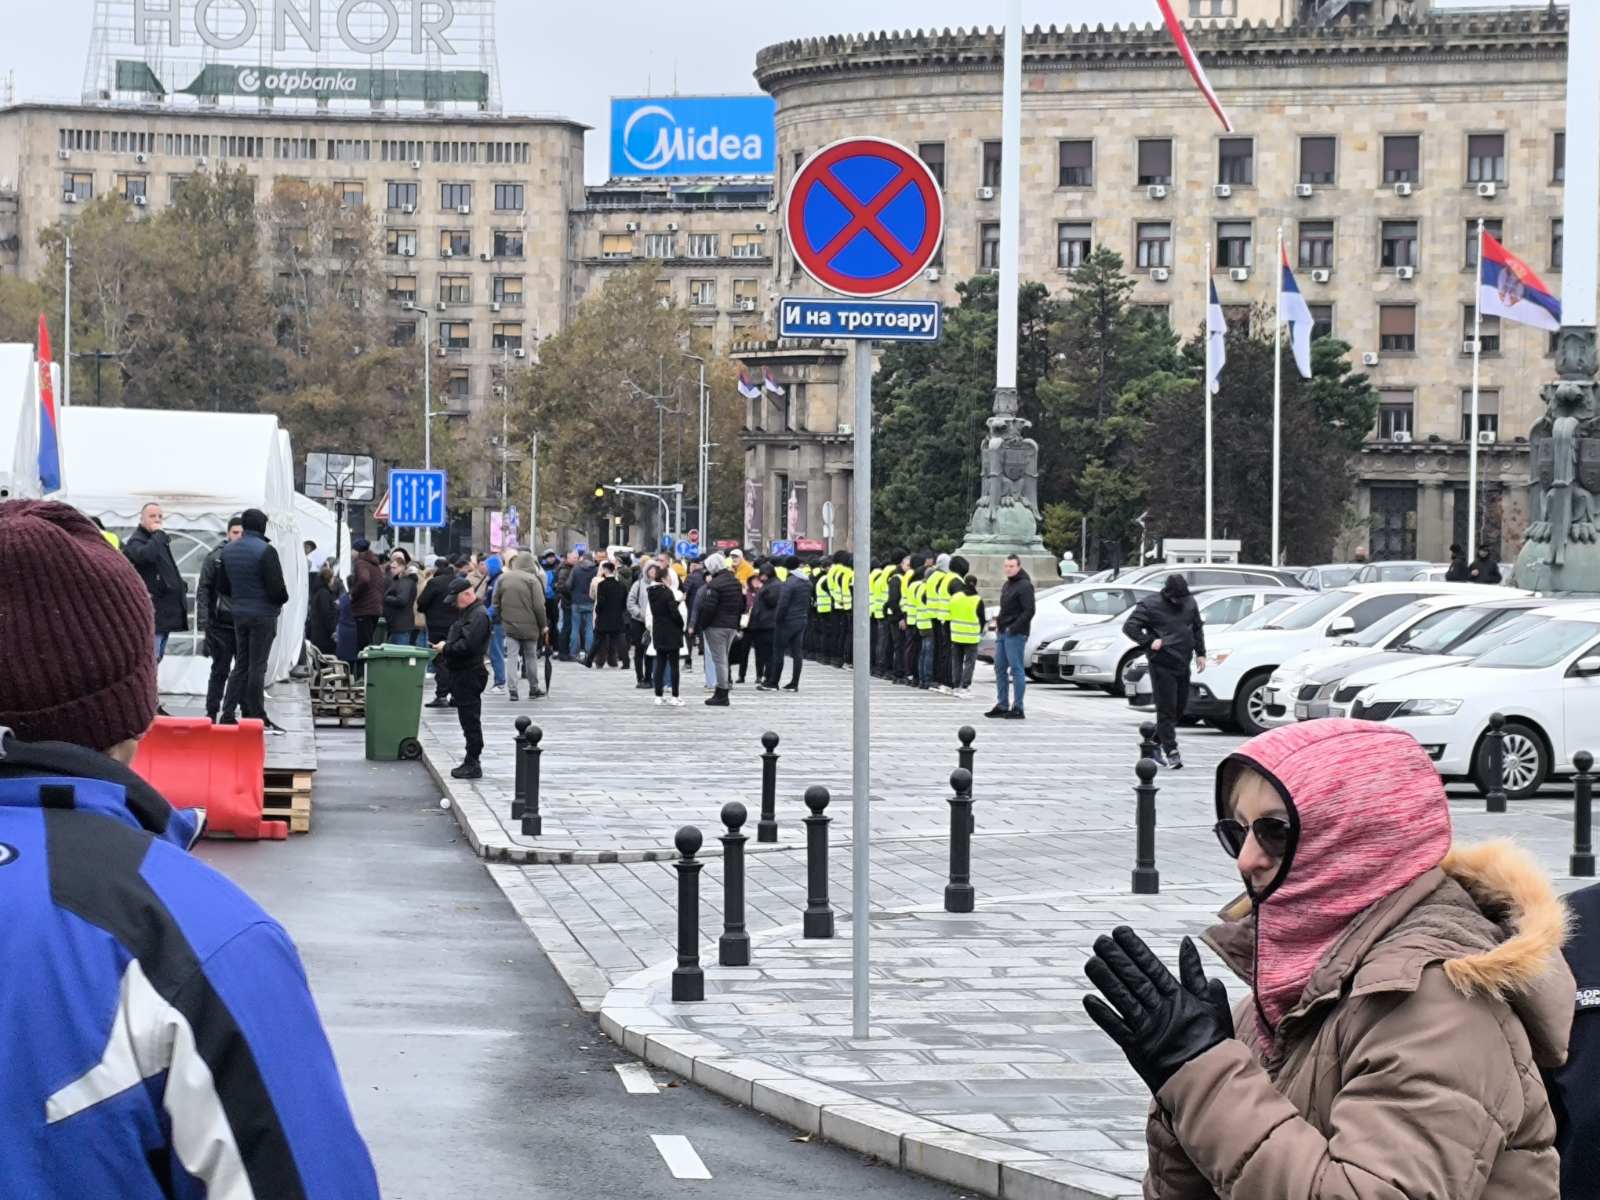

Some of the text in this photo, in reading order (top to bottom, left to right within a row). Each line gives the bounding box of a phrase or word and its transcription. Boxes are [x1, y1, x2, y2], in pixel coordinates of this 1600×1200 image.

[134, 0, 457, 55] HONOR
[264, 74, 357, 95] otpbanka
[644, 126, 762, 162] Midea
[786, 305, 935, 333] И на тротоару
